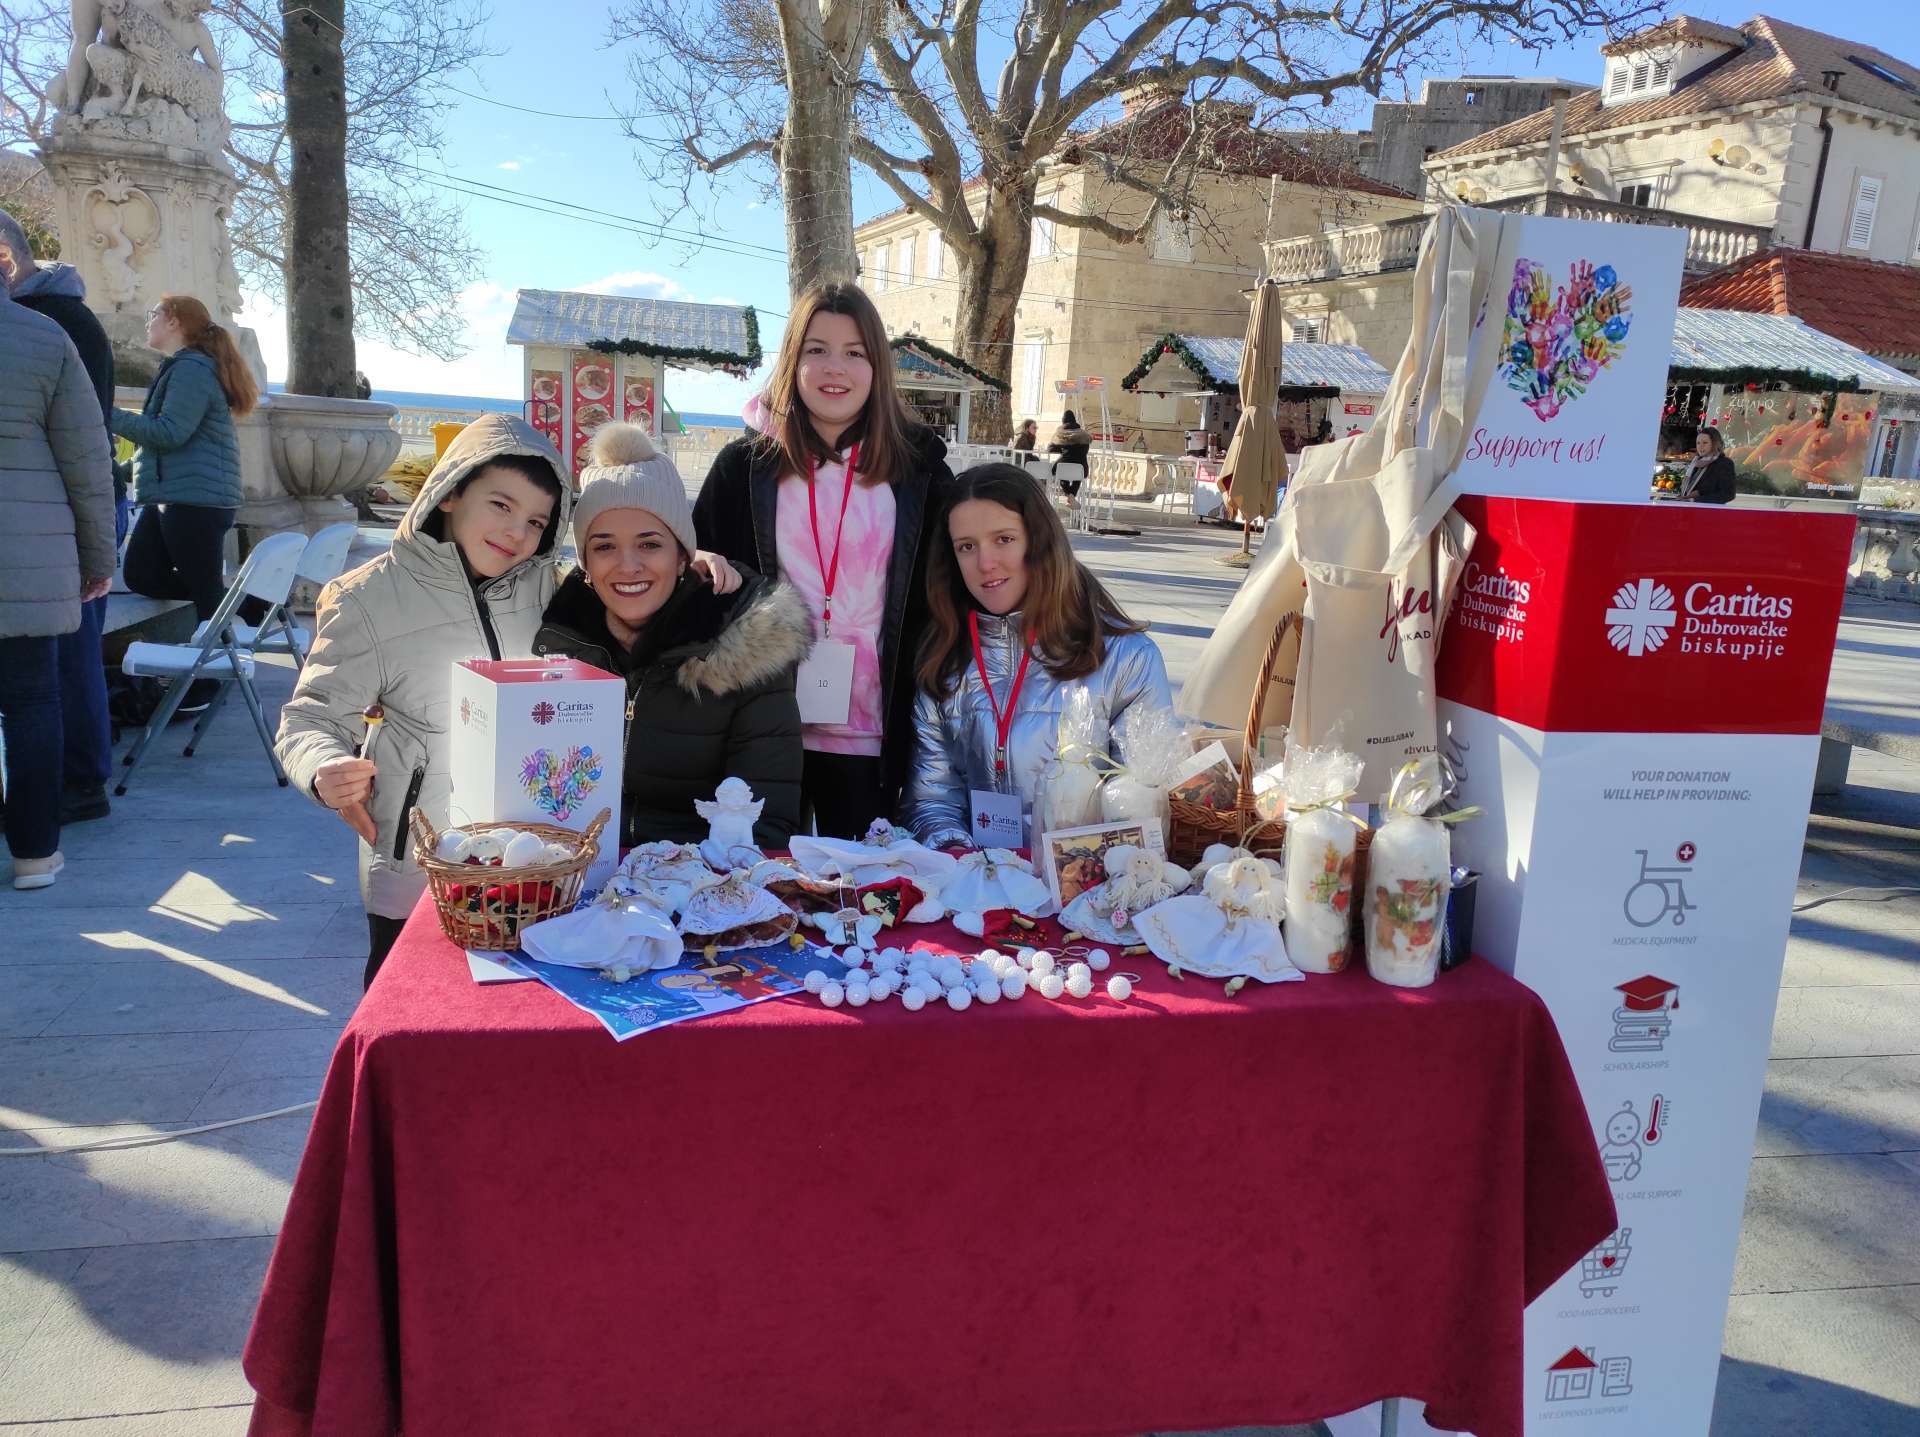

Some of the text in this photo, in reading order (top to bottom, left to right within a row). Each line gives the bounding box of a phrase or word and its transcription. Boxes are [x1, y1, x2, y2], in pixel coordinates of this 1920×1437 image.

[1466, 428, 1605, 468] Support us!
[1463, 561, 1531, 604] Caritas
[1462, 593, 1527, 622] Dubrovačke
[1684, 582, 1793, 619] Caritas
[1459, 611, 1524, 643] biskupije
[1684, 617, 1788, 637] Dubrovačke
[1680, 636, 1785, 660] biskupije
[817, 679, 829, 688] 10
[556, 700, 594, 711] Caritas
[1631, 770, 1731, 783] YOUR DONATION
[1603, 788, 1752, 801] WILL HELP IN PROVIDING:
